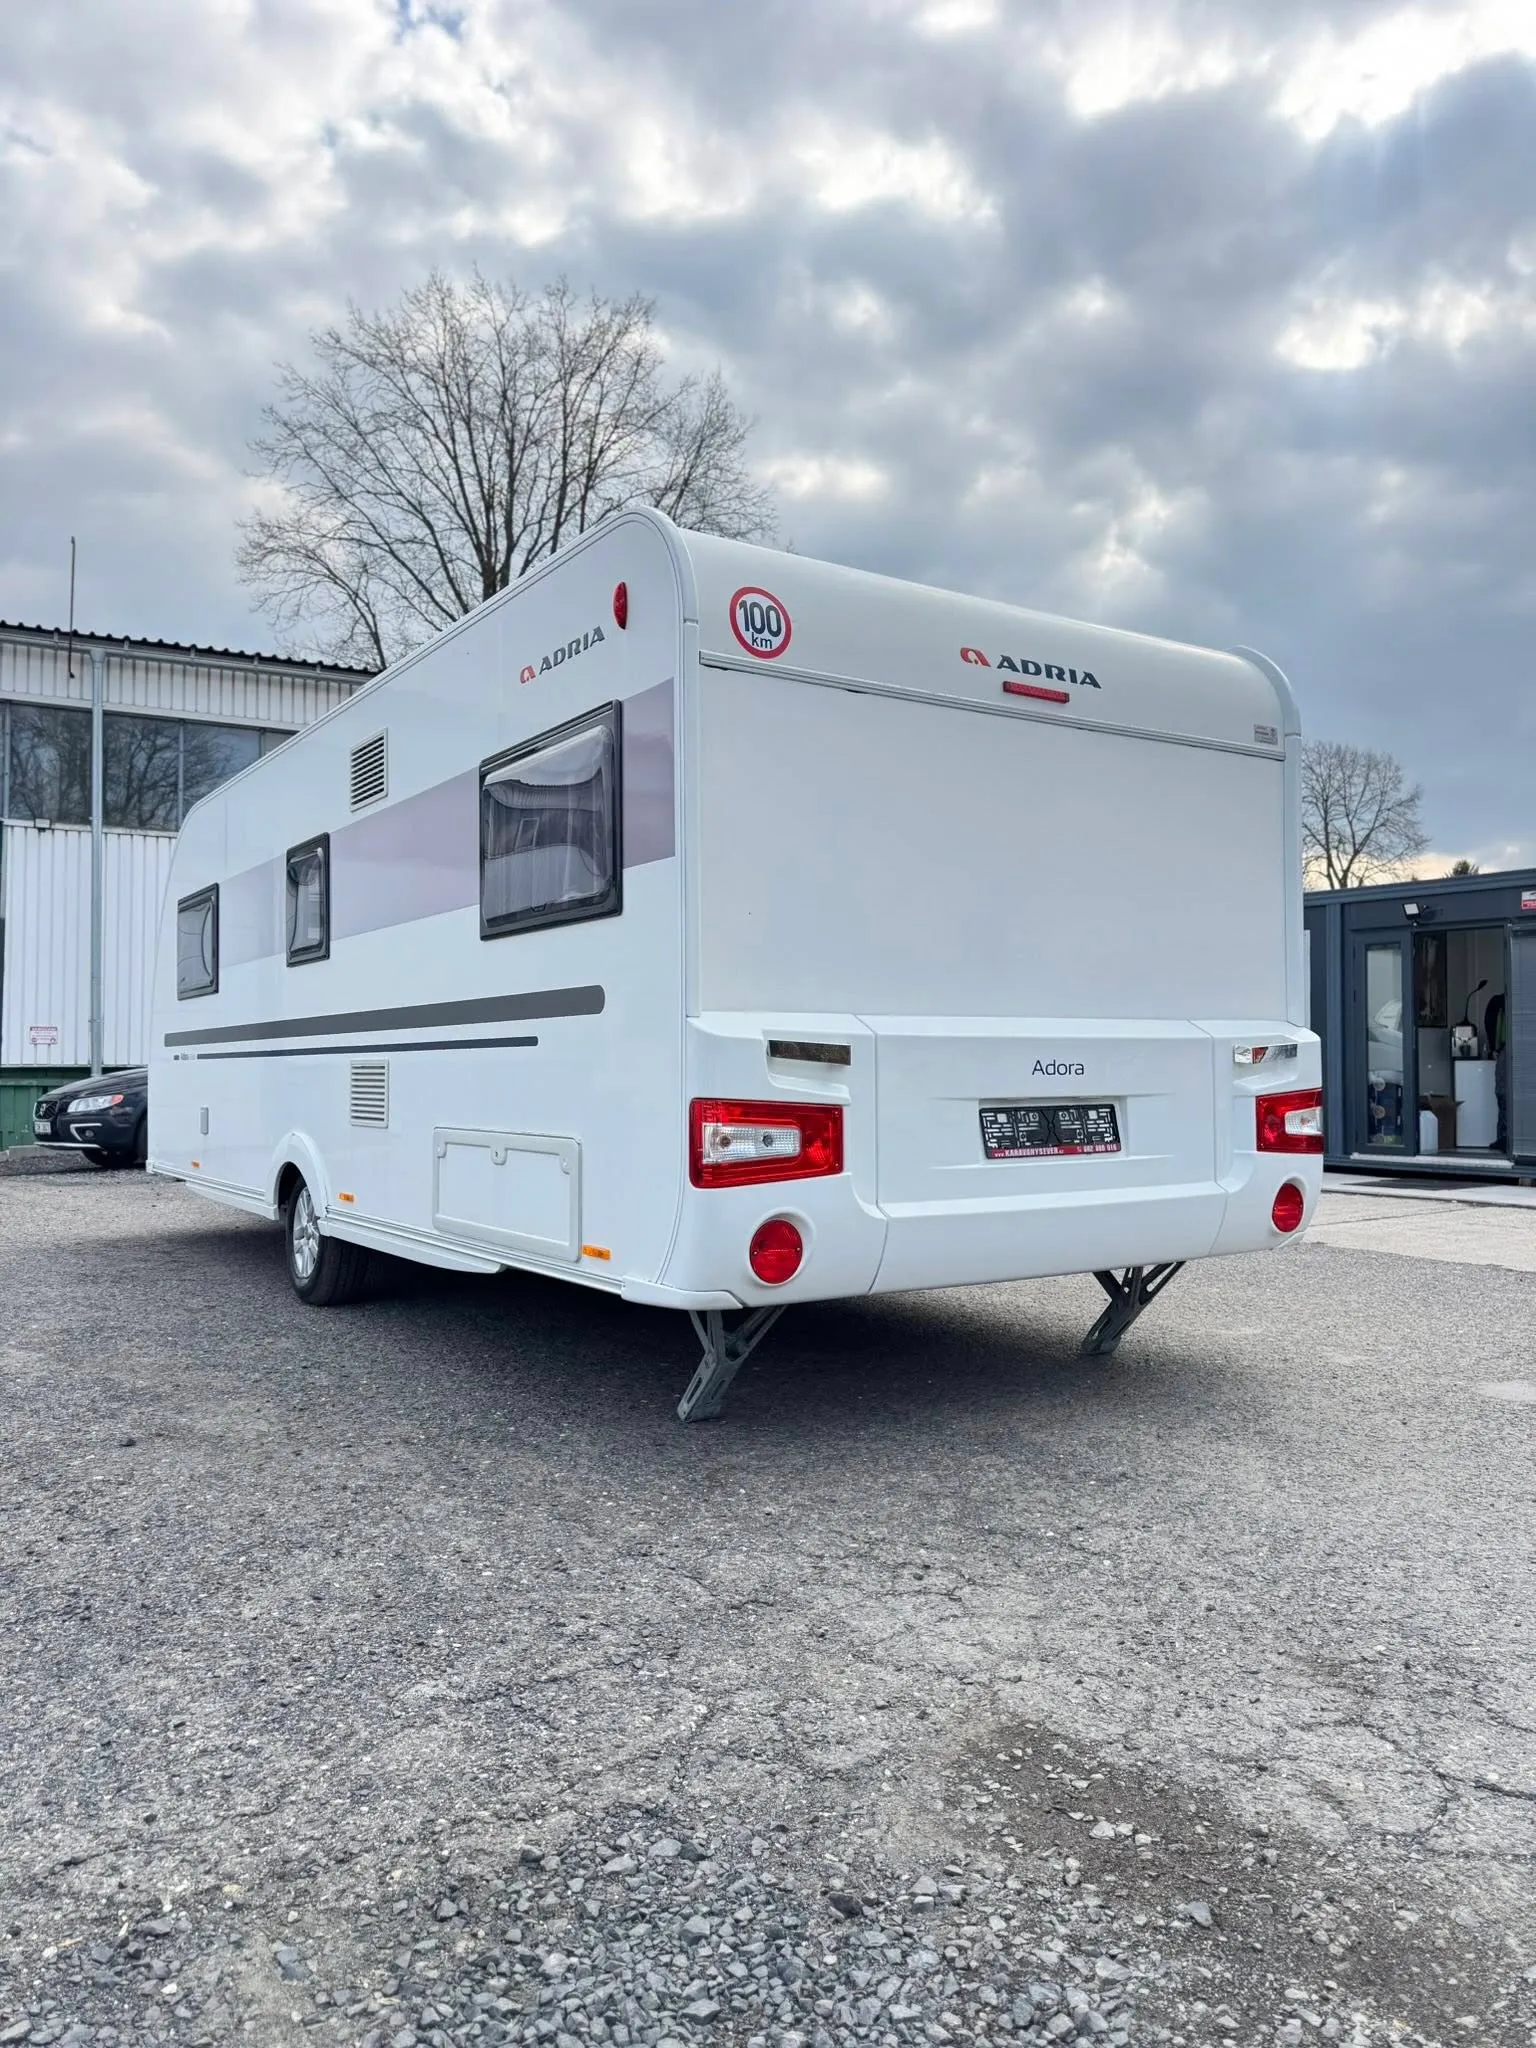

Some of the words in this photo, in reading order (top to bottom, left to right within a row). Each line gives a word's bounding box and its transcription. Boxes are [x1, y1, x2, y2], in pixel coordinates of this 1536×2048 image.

[739, 599, 782, 638] 100
[539, 625, 605, 675] ADRIA
[751, 631, 773, 650] km
[996, 654, 1102, 689] ADRIA
[1031, 1058, 1085, 1076] Adora
